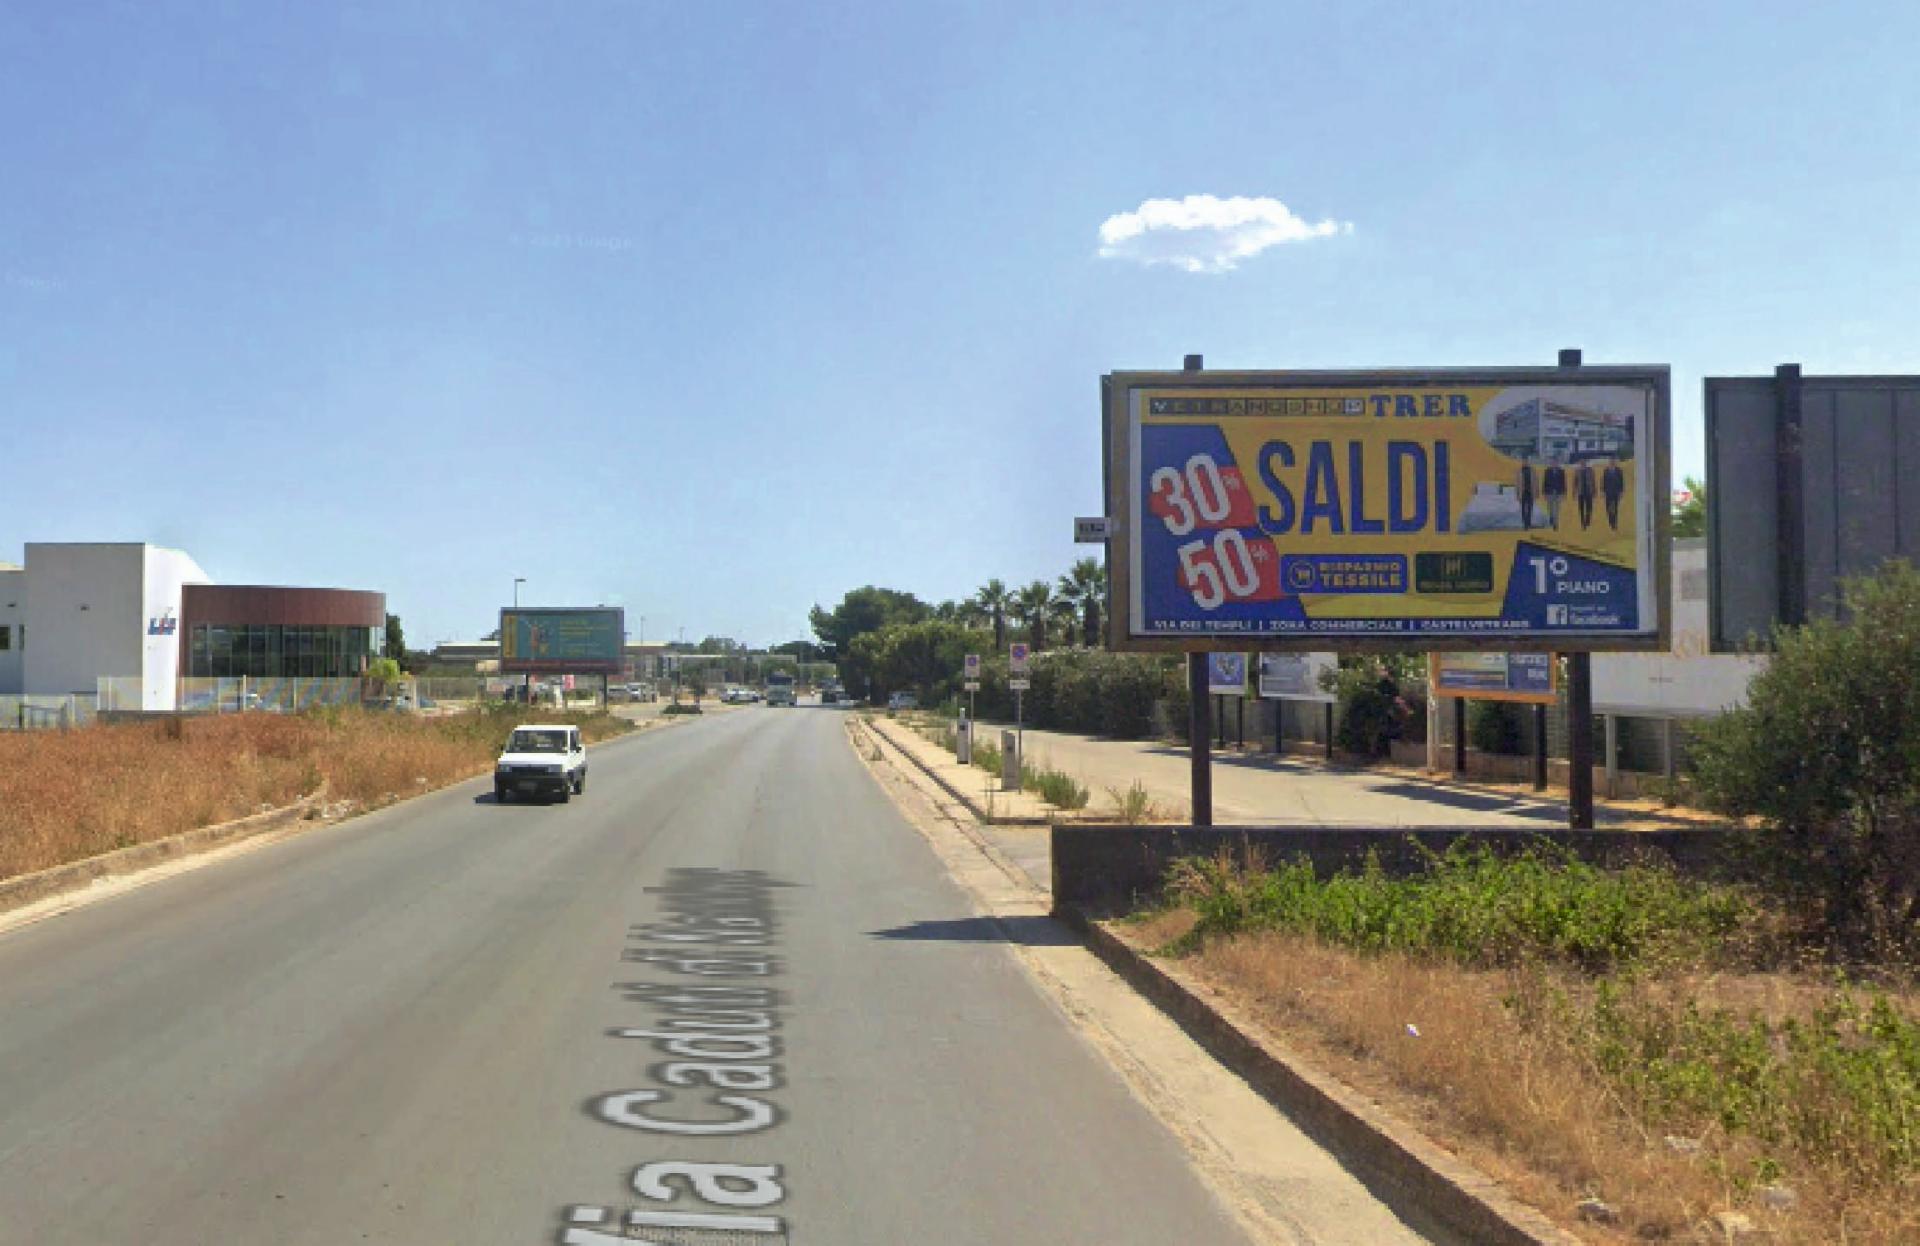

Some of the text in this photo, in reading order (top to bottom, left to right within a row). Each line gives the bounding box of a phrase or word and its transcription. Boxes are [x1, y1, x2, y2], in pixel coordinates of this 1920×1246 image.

[1369, 395, 1471, 417] TRER
[1258, 440, 1450, 535] SALDI
[1321, 573, 1401, 587] TESSILE
[1557, 582, 1609, 594] PIANO
[1154, 620, 1176, 630] VIA
[1205, 620, 1252, 630] TEMPLI
